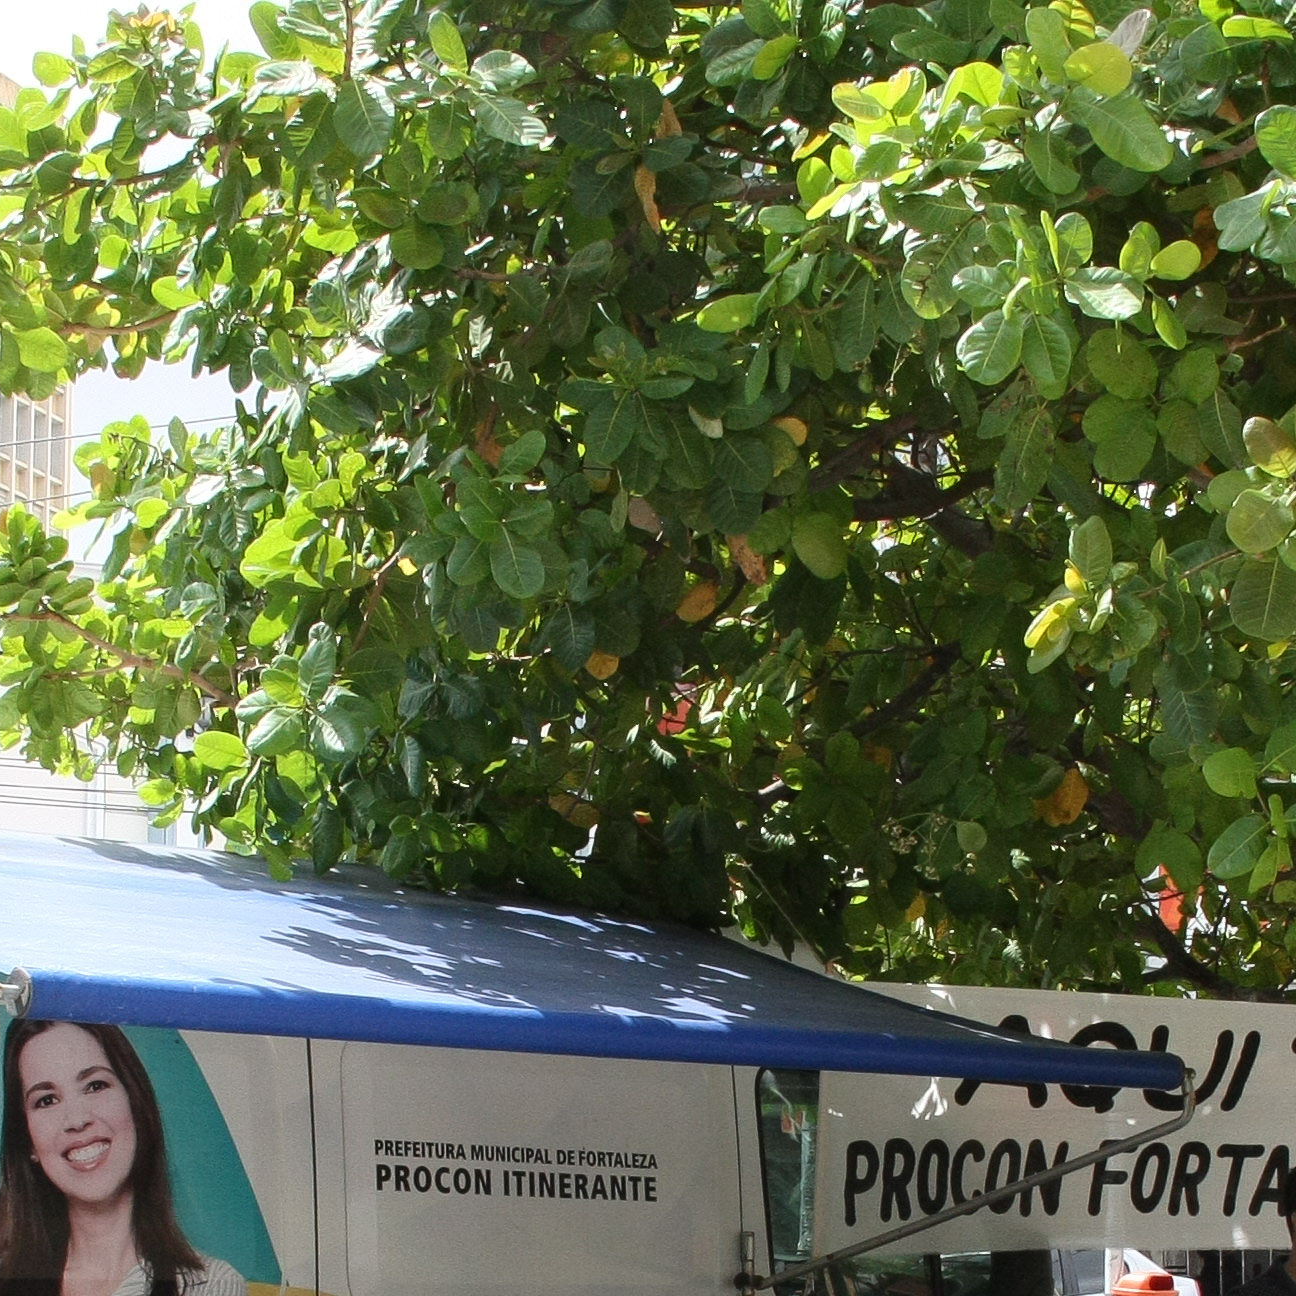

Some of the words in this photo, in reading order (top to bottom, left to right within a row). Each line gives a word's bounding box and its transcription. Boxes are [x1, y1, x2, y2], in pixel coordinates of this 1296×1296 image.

[374, 1139, 467, 1160] PREFEITURA
[470, 1144, 553, 1165] MUNICIPAL
[556, 1149, 576, 1166] DE
[578, 1150, 659, 1170] FORTALEZA
[375, 1163, 493, 1196] PROCON
[503, 1170, 659, 1202] ITINERANTE
[844, 1136, 1069, 1226] PROCON
